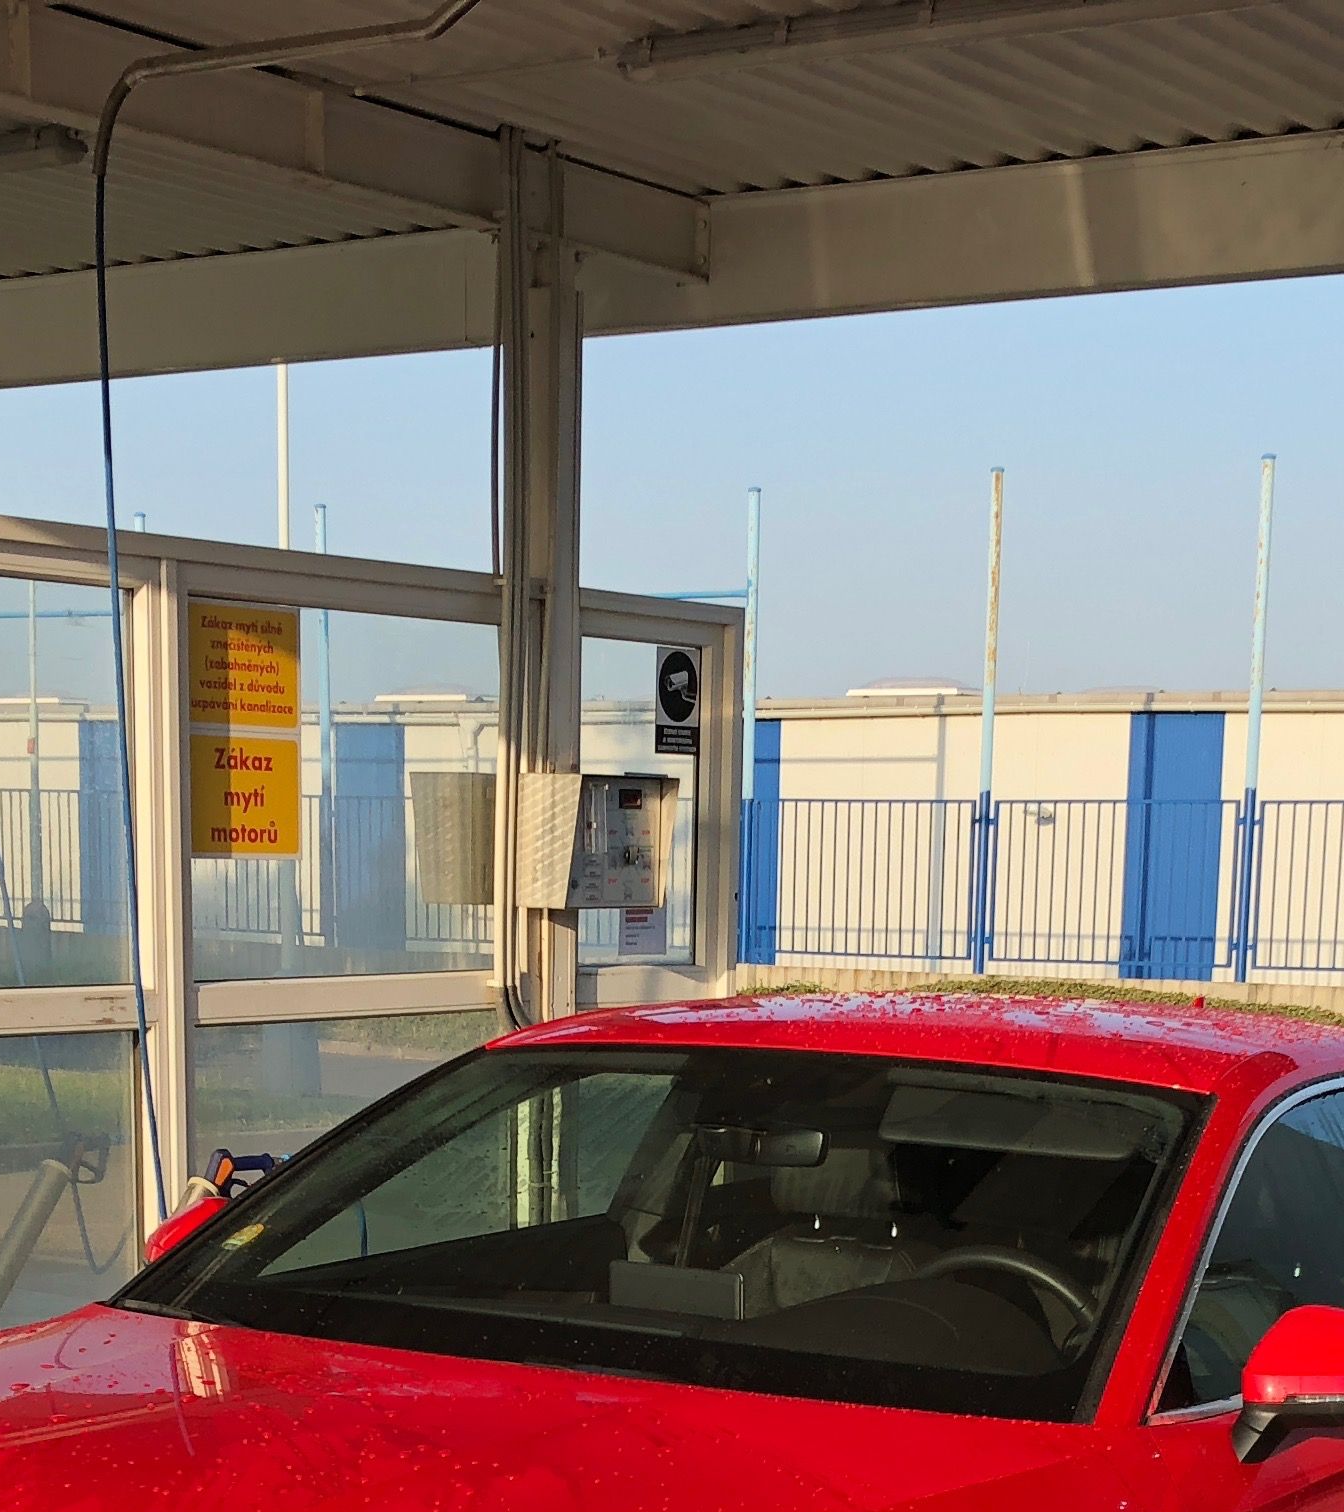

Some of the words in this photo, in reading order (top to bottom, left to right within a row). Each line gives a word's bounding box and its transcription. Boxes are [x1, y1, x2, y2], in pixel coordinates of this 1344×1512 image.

[201, 615, 233, 630] Zákaz
[235, 619, 258, 635] mytí
[210, 637, 274, 656] znečištěných
[199, 677, 237, 691] vozidel
[239, 682, 245, 691] z
[247, 679, 285, 695] důvodu
[191, 696, 238, 712] ucpávání
[239, 699, 294, 715] kanalizace
[214, 747, 273, 772] Zákaz
[223, 785, 265, 813] mytí
[211, 820, 278, 845] motorů
